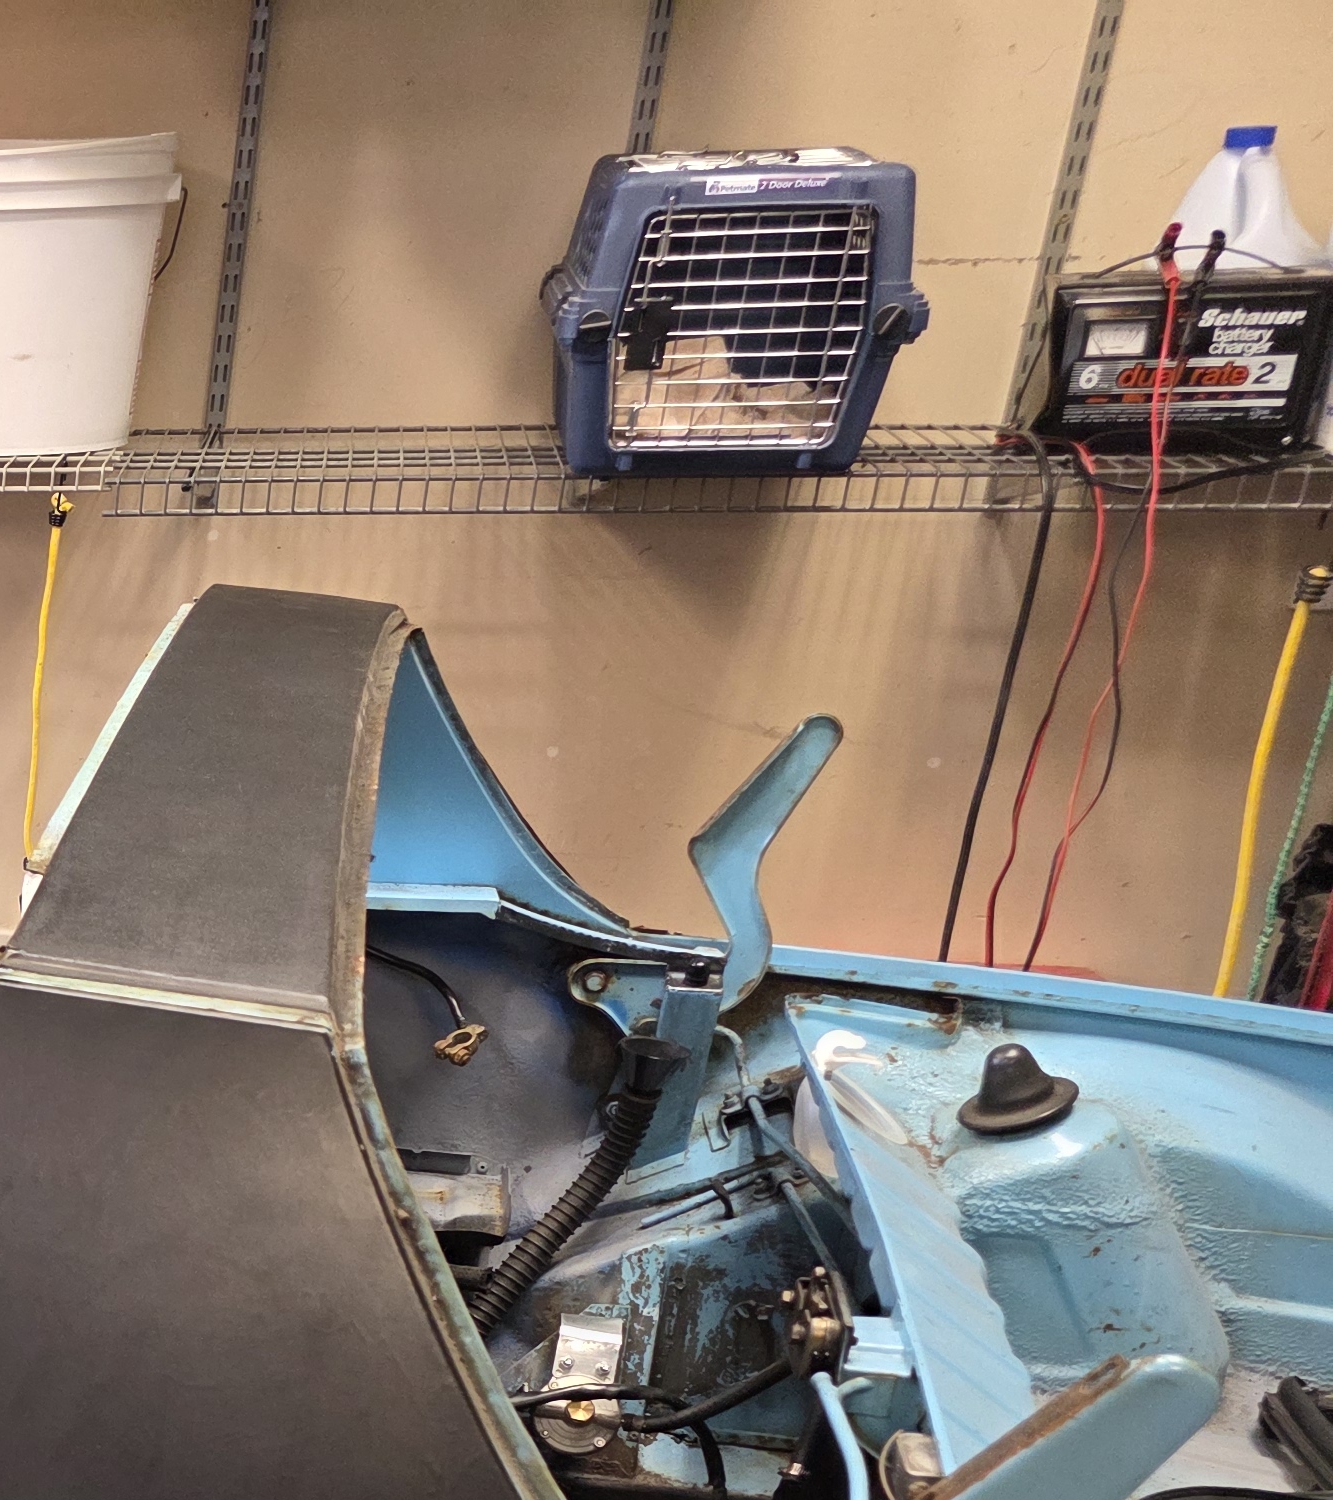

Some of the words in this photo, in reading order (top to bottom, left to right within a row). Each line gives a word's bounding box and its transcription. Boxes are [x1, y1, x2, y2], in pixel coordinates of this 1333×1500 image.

[720, 183, 756, 193] Petmate
[768, 180, 792, 189] Door
[794, 178, 828, 188] Deluxe
[1198, 307, 1307, 327] Schauer
[1212, 326, 1274, 344] battery
[1208, 340, 1274, 357] charger
[1078, 364, 1102, 389] 6
[1120, 361, 1186, 387] dual
[1188, 361, 1248, 386] rate
[1250, 361, 1276, 385] 2
